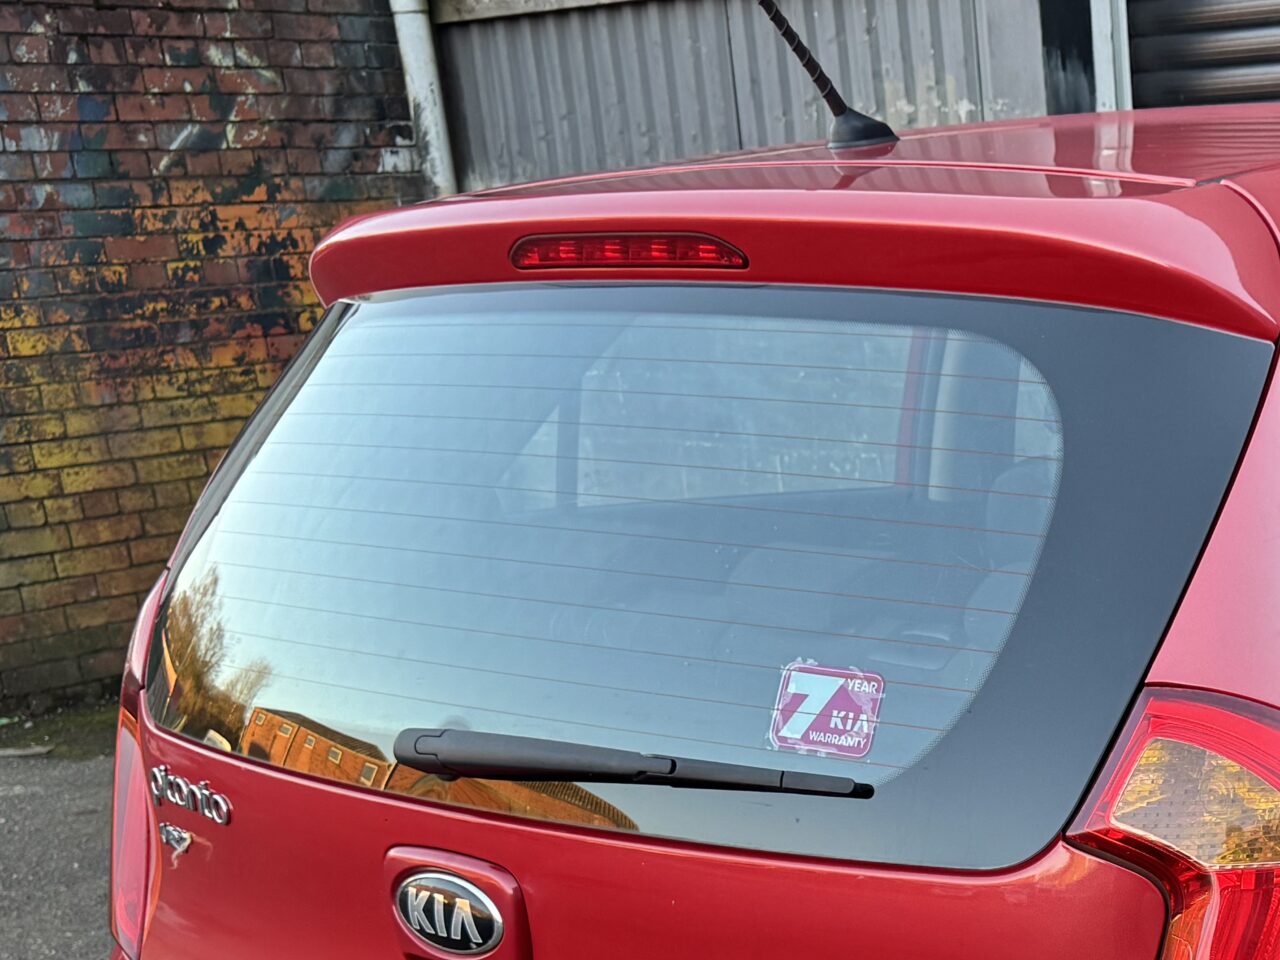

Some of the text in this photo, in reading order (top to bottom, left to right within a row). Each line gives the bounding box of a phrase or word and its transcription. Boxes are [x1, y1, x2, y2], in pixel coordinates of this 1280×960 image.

[778, 671, 878, 739] 7 YEAR
[830, 709, 869, 733] KIA
[809, 730, 867, 748] WARRANTY
[408, 886, 482, 943] KIA
